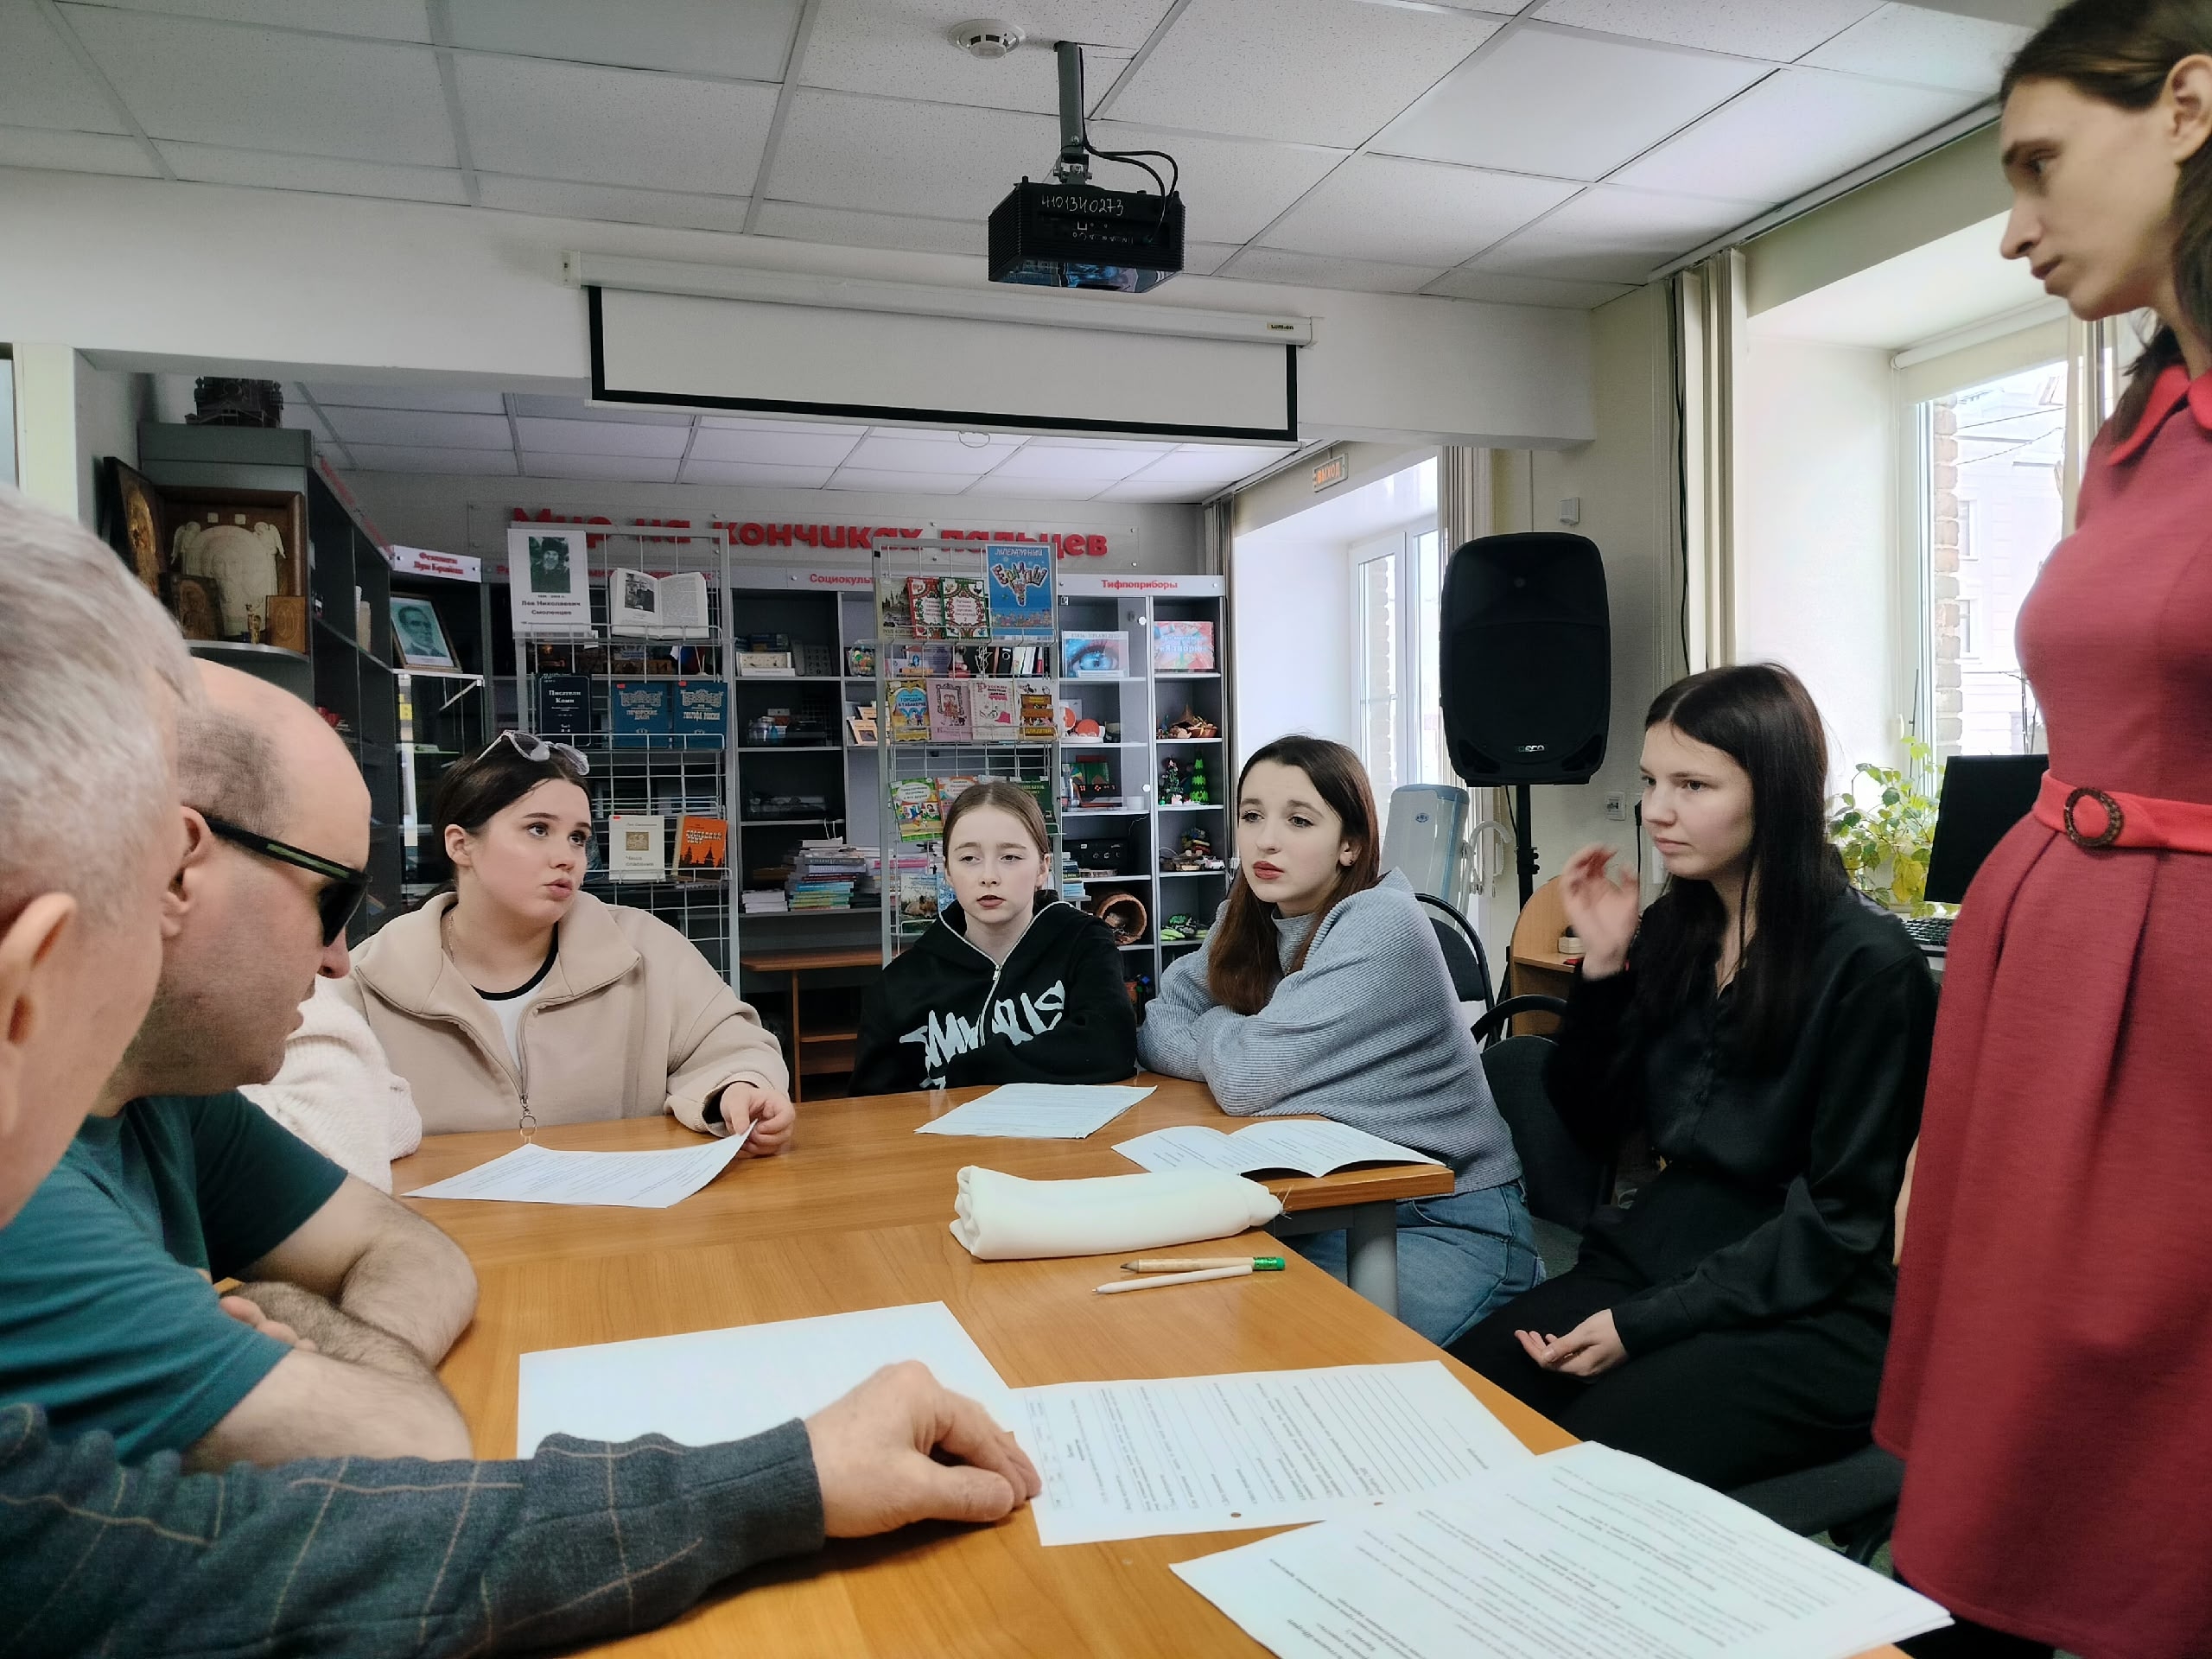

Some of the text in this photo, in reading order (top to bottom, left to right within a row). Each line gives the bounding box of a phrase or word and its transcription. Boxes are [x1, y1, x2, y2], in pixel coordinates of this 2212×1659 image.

[1317, 461, 1341, 484] ВЫХОД
[995, 548, 1043, 556] ЛИТЕРАТУРНЫЙ
[1101, 580, 1178, 590] Тифлоприборы
